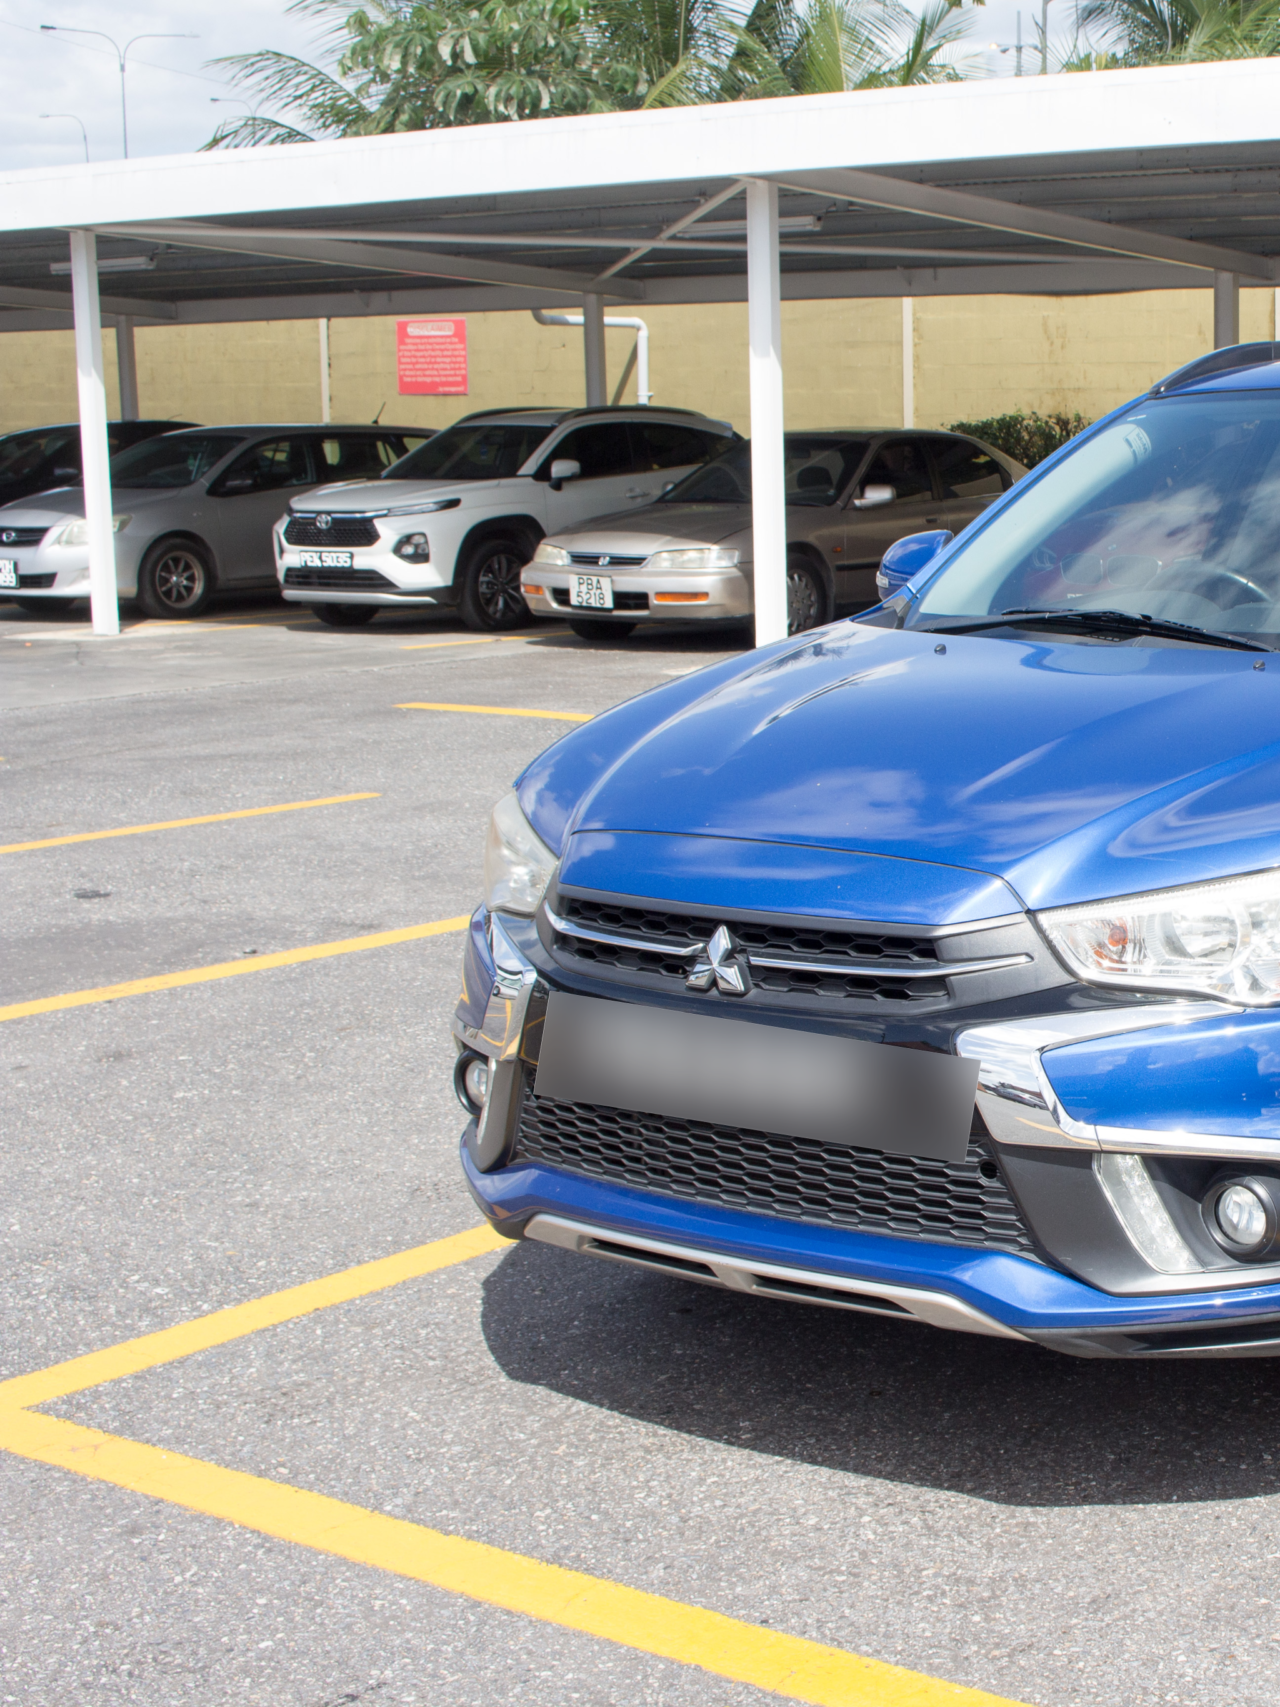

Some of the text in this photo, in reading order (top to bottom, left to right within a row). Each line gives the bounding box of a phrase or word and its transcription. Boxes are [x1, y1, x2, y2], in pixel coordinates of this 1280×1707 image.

[300, 551, 351, 567] PEK 5035
[577, 576, 602, 591] PBA
[576, 590, 605, 606] 5218
